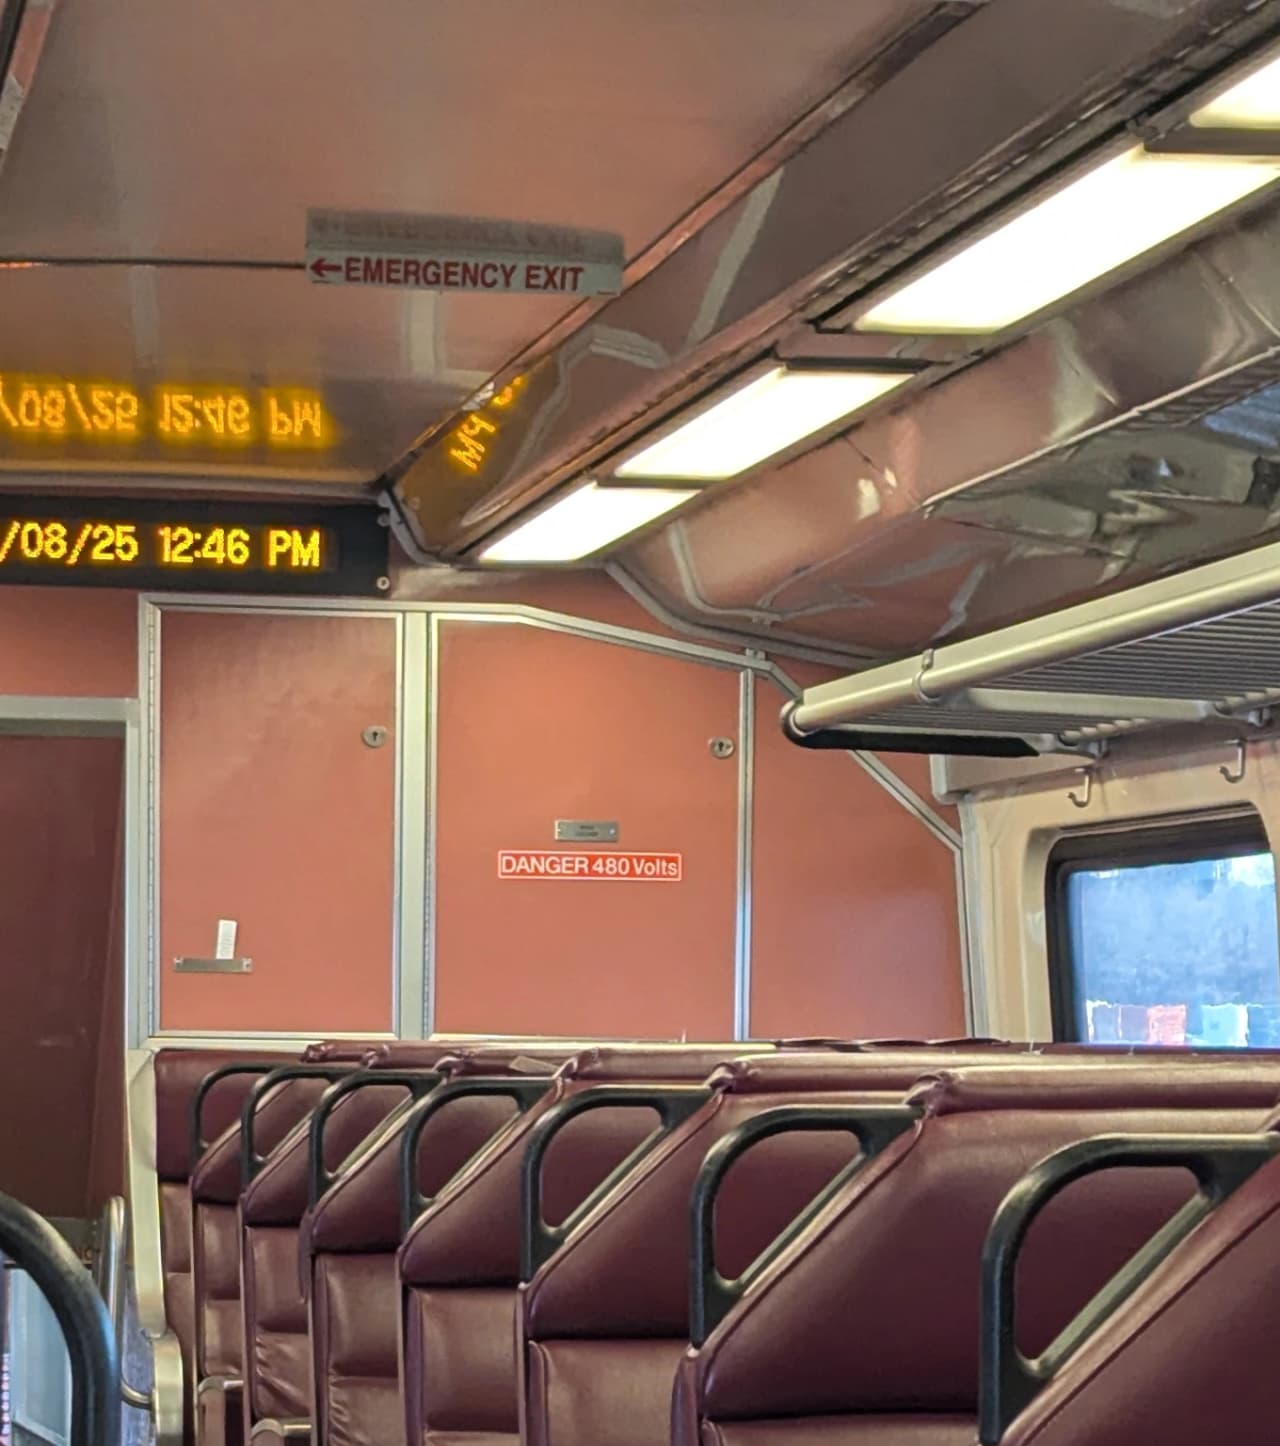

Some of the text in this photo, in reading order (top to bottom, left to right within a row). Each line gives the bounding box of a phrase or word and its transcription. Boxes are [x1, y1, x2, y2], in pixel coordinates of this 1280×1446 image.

[345, 257, 584, 291] EMERGENCY EXIT
[158, 525, 250, 564] 12:46
[268, 529, 320, 567] PM
[501, 856, 678, 876] DANGER 480 Volts
